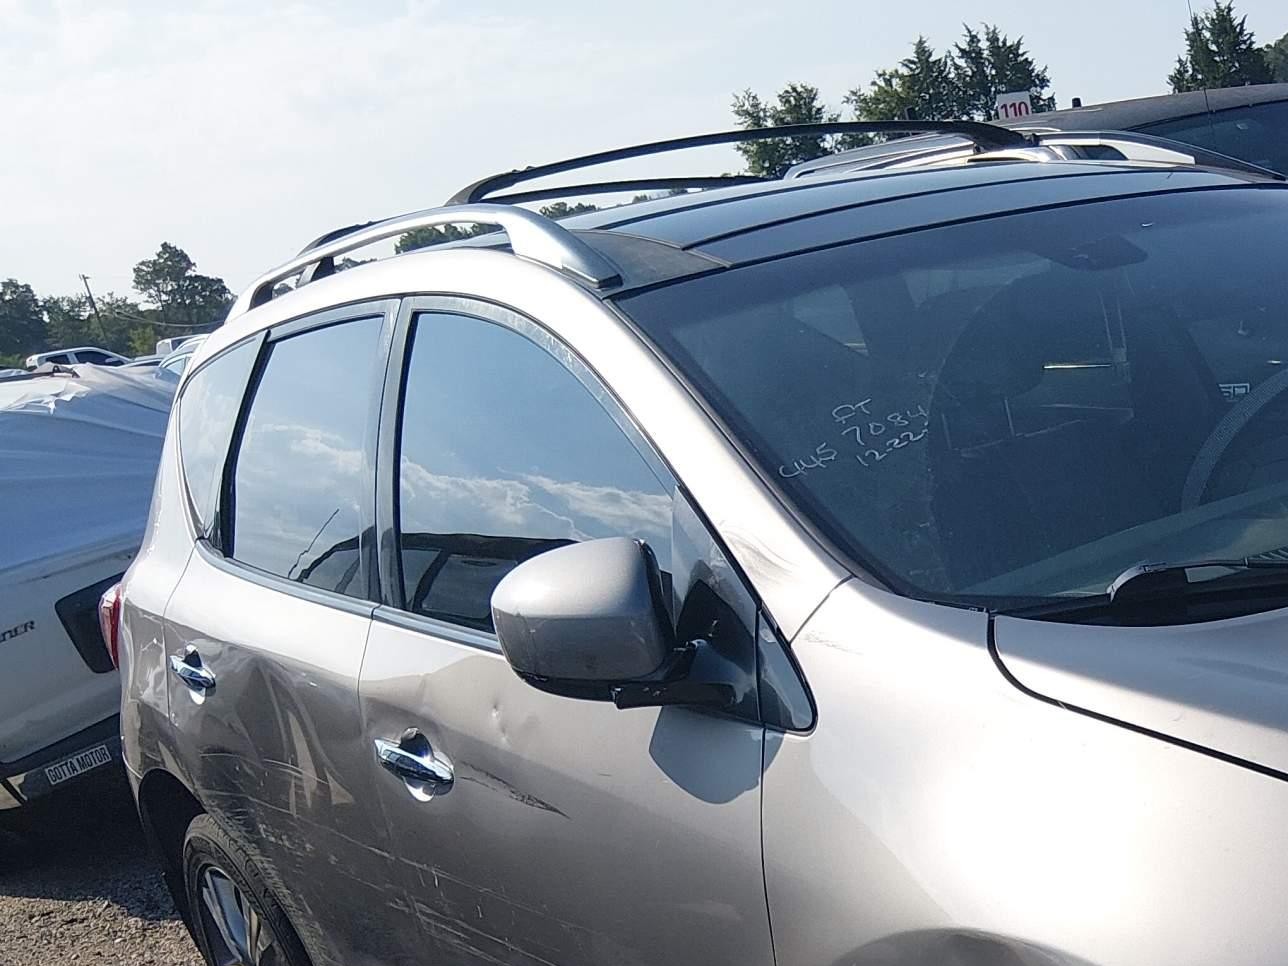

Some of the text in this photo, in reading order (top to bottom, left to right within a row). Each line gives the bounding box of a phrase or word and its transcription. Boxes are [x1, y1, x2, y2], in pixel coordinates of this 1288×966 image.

[999, 101, 1030, 119] 110
[48, 747, 110, 782] GOTTA MOTOR
